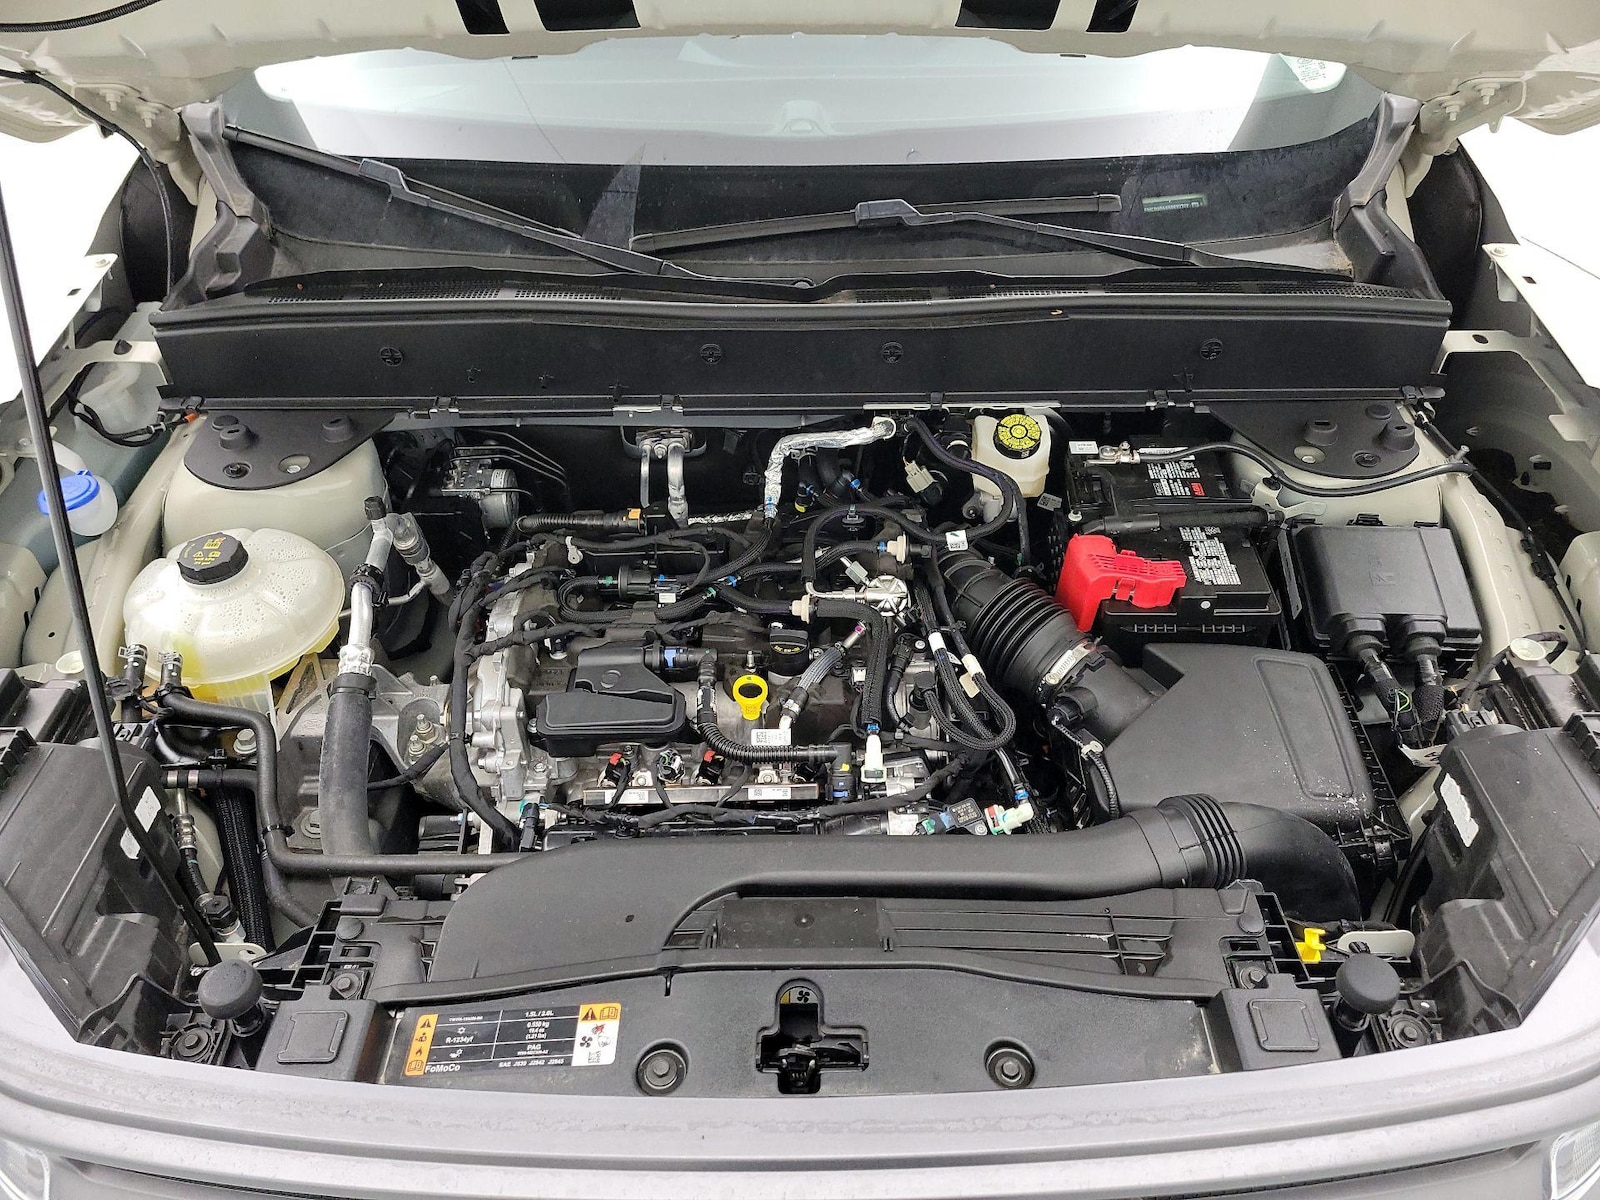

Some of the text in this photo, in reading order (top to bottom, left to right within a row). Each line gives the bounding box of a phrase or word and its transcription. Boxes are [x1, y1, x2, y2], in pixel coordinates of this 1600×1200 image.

[1191, 483, 1202, 496] AGM
[445, 1036, 474, 1044] R-1234yf
[425, 1064, 461, 1073] FoMoCo
